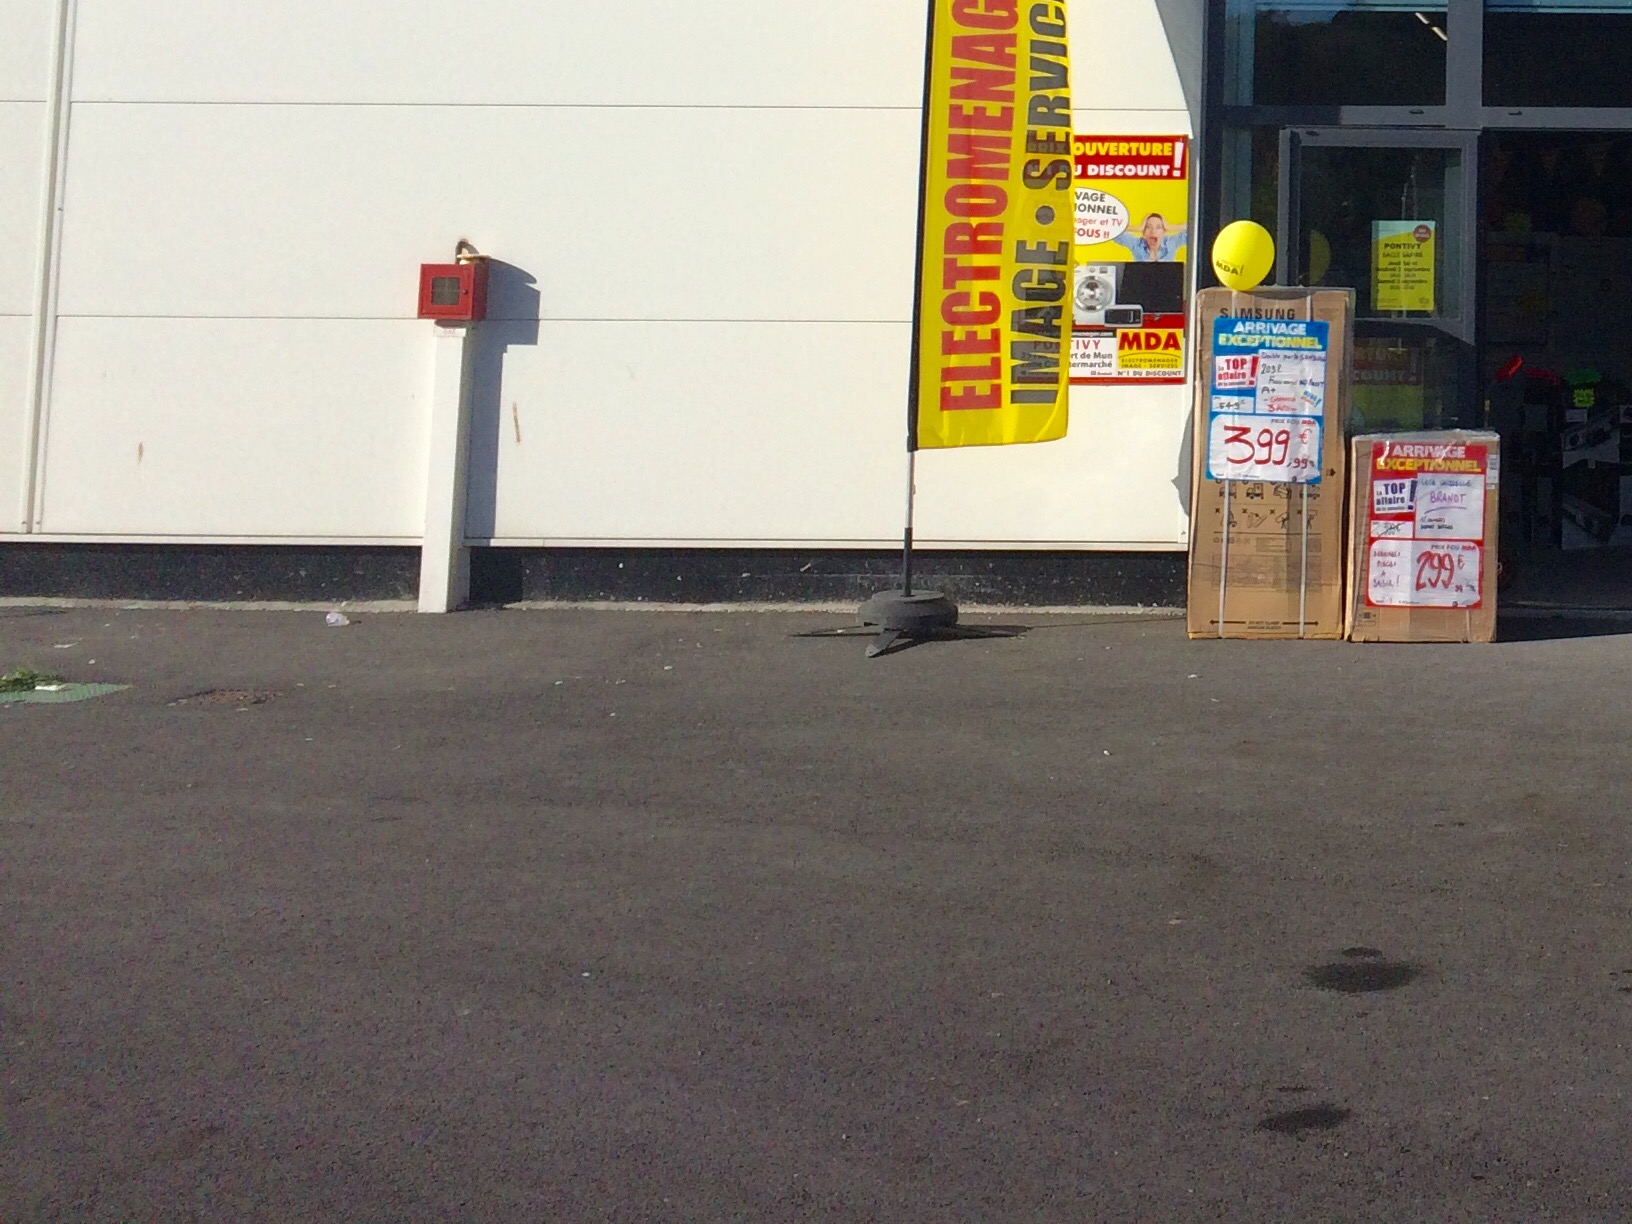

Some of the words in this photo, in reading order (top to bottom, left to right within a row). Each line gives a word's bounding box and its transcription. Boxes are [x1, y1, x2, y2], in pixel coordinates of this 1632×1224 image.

[1087, 164, 1170, 176] DISCOUNT
[1010, 239, 1070, 405] IMAGE
[1233, 321, 1307, 336] ARRIVAGE
[1118, 332, 1182, 351] MDA
[1218, 334, 1323, 349] EXCEPTIONNEL
[1225, 358, 1248, 370] TOP
[1392, 445, 1466, 459] ARRIVAGE
[1376, 458, 1482, 473] EXCEPTIONNEL
[1383, 482, 1406, 495] TOP
